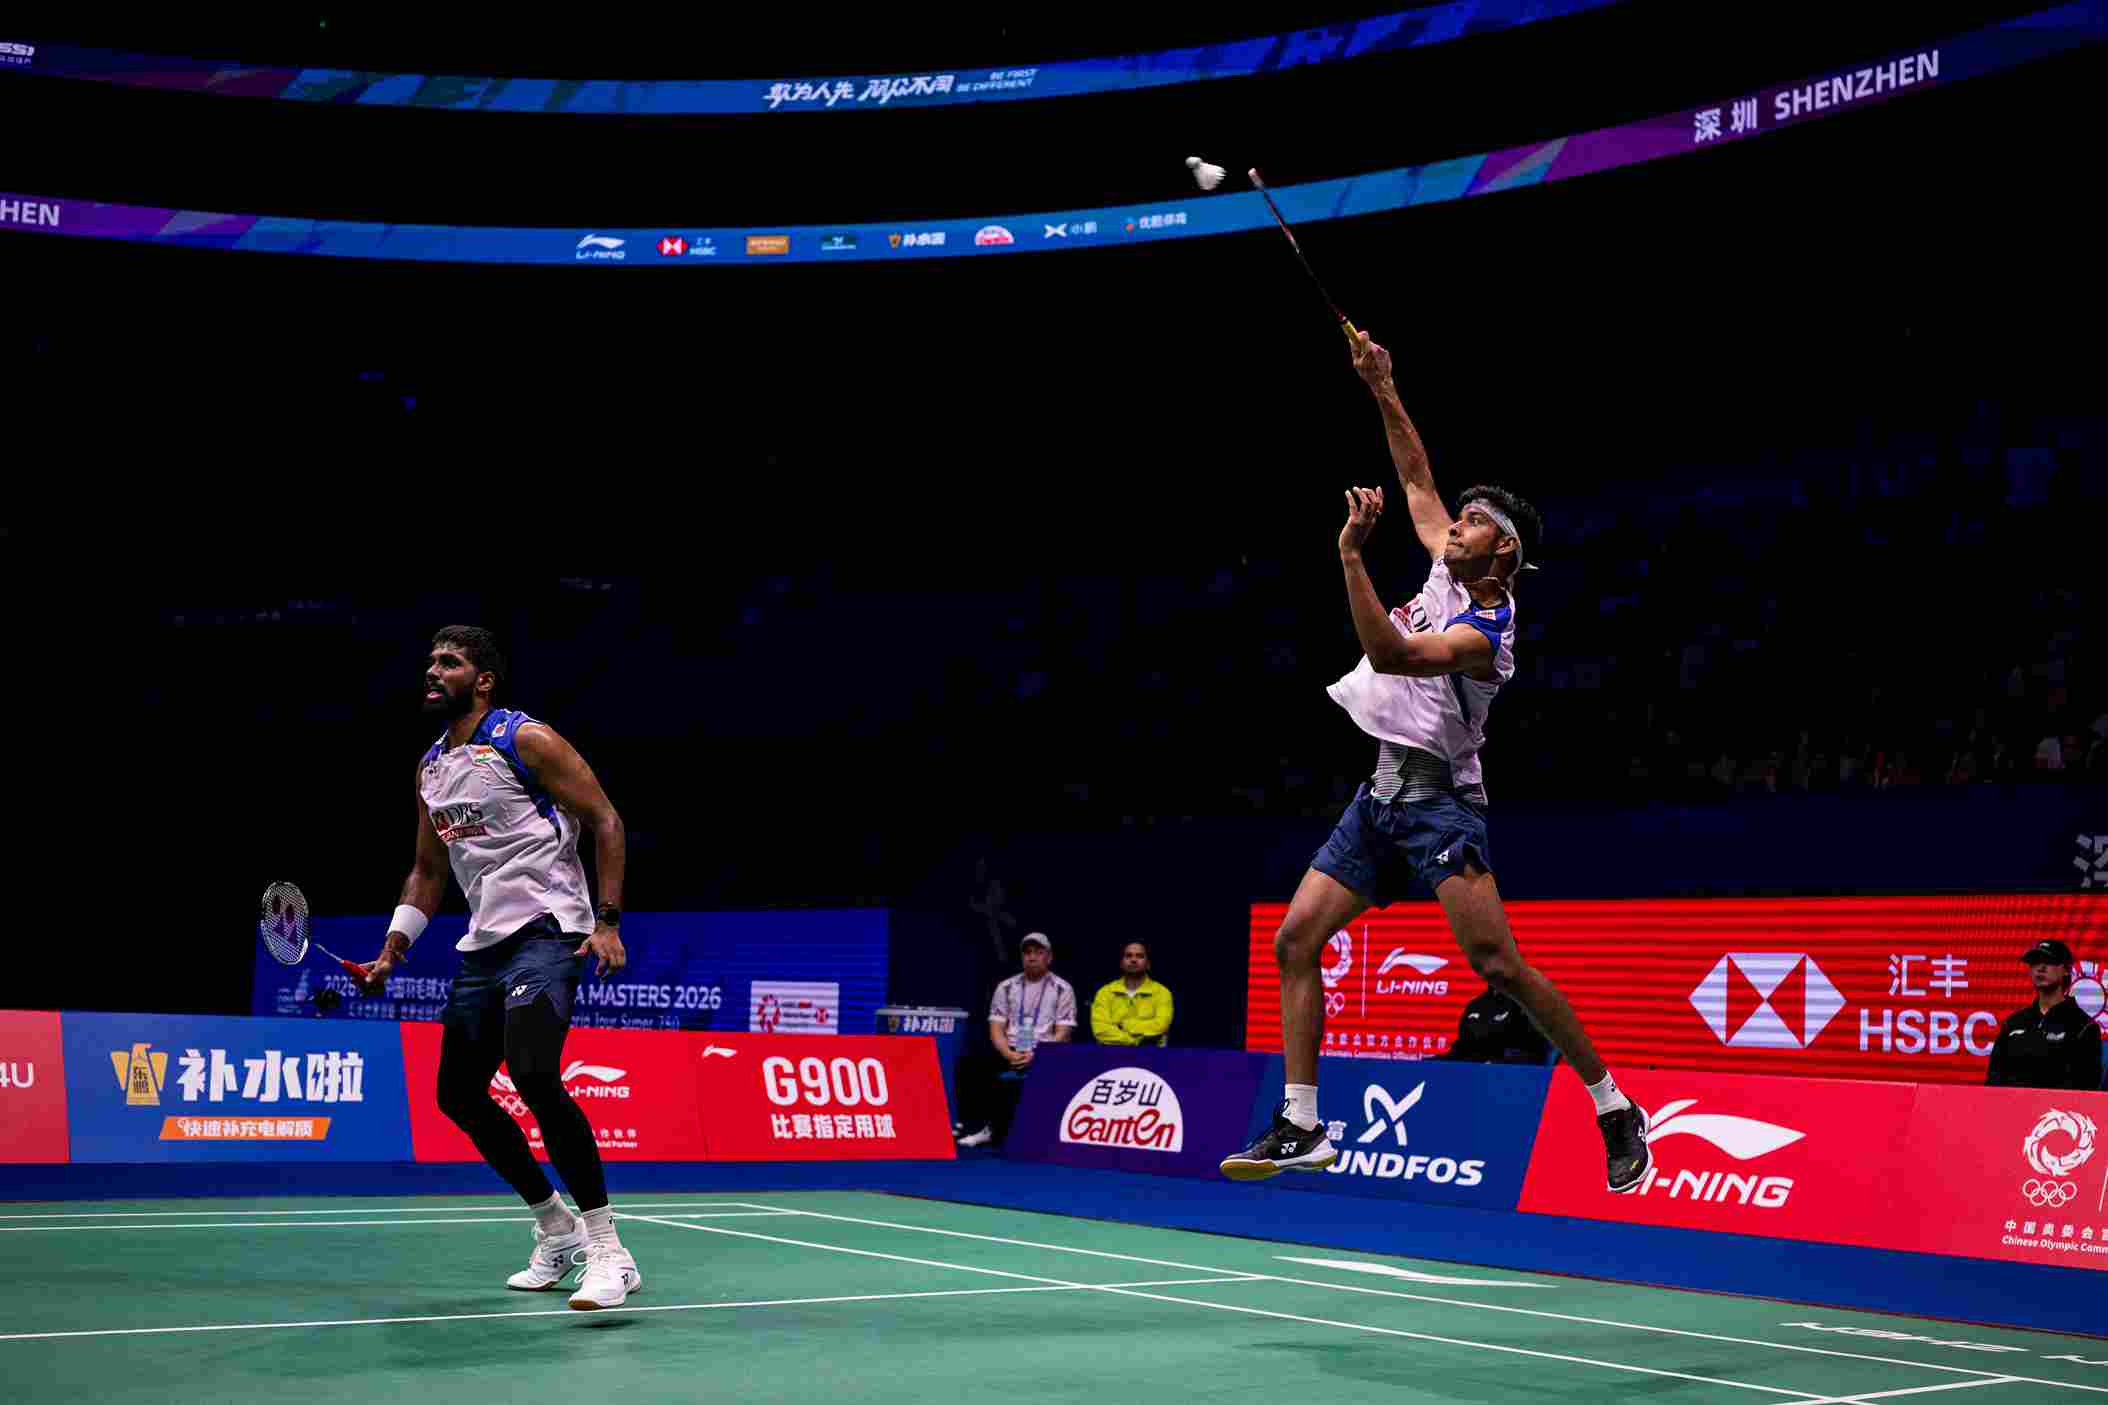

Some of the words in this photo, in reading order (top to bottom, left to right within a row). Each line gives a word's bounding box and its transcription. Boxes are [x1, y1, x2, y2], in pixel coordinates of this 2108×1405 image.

[1774, 50, 1939, 120] SHENZHEN
[1694, 98, 1758, 143] 深圳
[1376, 979, 1448, 994] LI-NING
[1889, 953, 1968, 998] 汇丰
[588, 984, 671, 1008] MASTERS
[674, 986, 722, 1009] 2026
[1859, 1008, 1998, 1056] HSBC
[177, 1049, 364, 1103] 补水啦
[762, 1056, 889, 1106] G900
[1090, 1080, 1162, 1106] 百岁山
[770, 1113, 896, 1138] 比赛指定用球
[1325, 1120, 1347, 1141] 富
[1326, 1150, 1485, 1186] UNDFOS
[1622, 1167, 1794, 1208] I-NING
[2002, 1235, 2038, 1247] Chinese
[2040, 1239, 2078, 1252] Olympic
